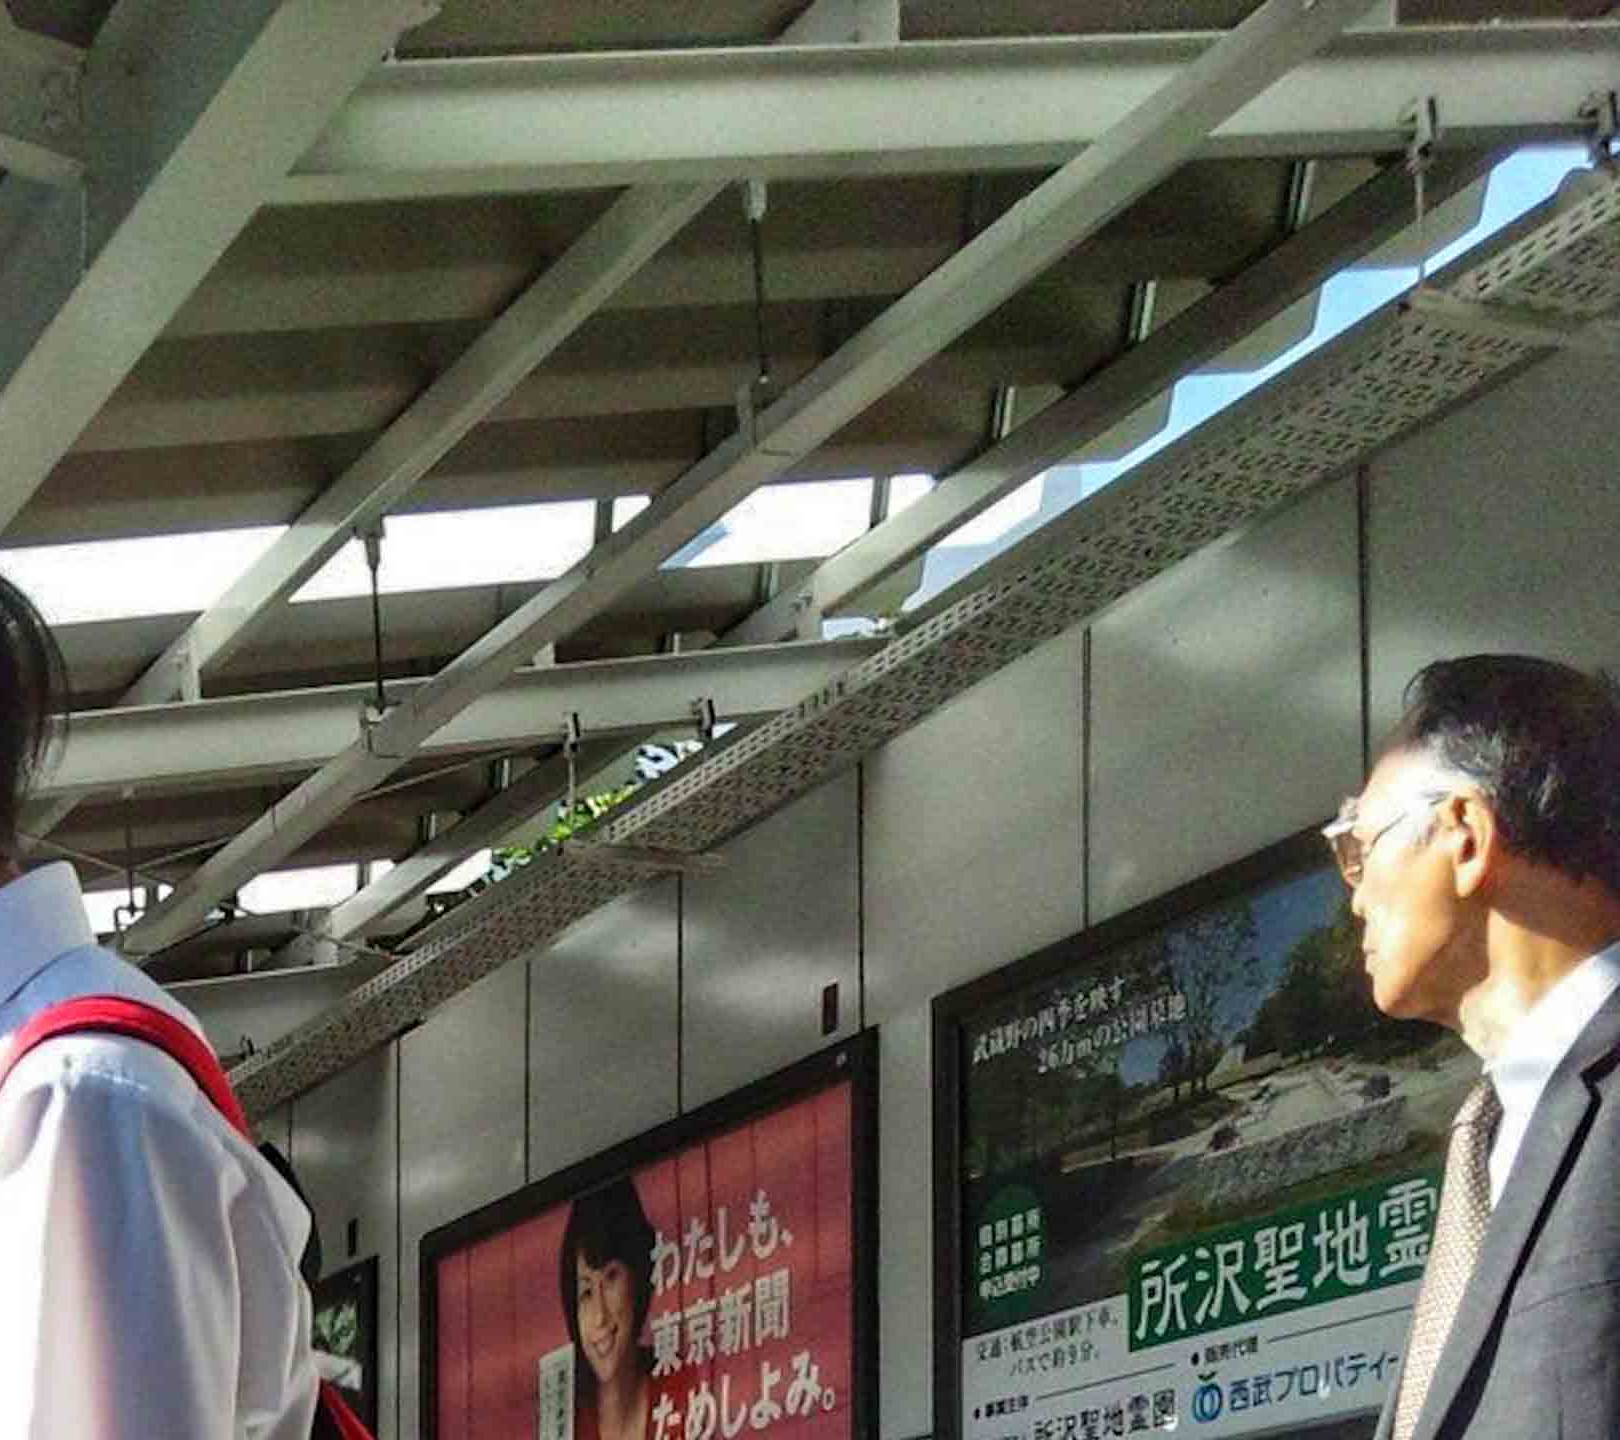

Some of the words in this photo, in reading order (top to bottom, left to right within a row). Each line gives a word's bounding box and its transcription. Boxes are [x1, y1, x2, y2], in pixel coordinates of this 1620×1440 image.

[650, 1189, 794, 1296] わたしも、
[1135, 1179, 1437, 1340] 所沢聖地霊
[650, 1267, 790, 1377] 東京新聞
